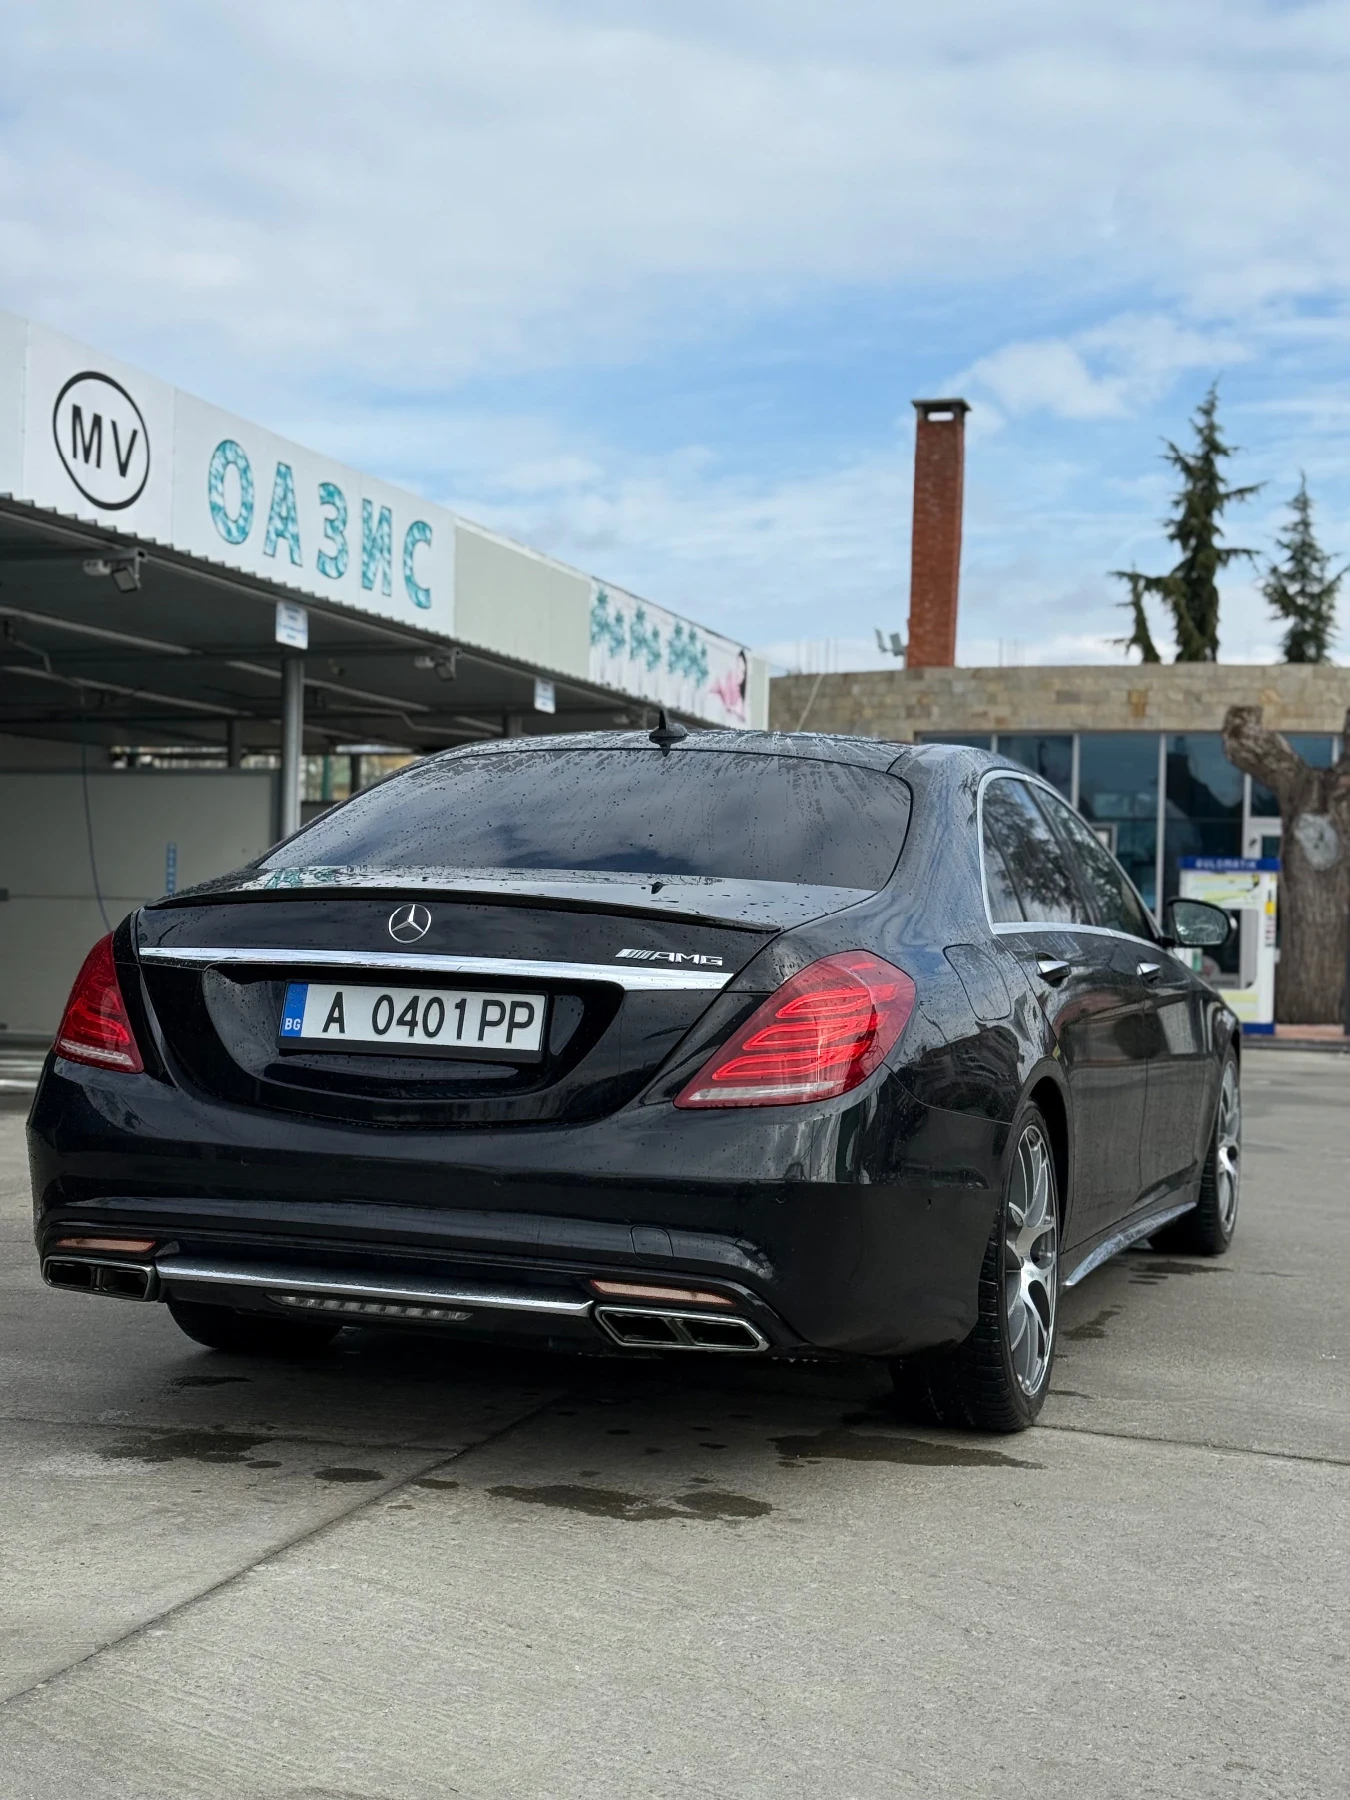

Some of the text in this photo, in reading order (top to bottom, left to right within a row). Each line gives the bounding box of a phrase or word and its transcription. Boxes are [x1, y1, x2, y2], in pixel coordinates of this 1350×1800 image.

[72, 404, 138, 478] MV
[208, 439, 432, 609] ОАЗИС
[648, 951, 723, 967] AMG
[285, 1018, 301, 1031] BG
[322, 992, 346, 1034] A
